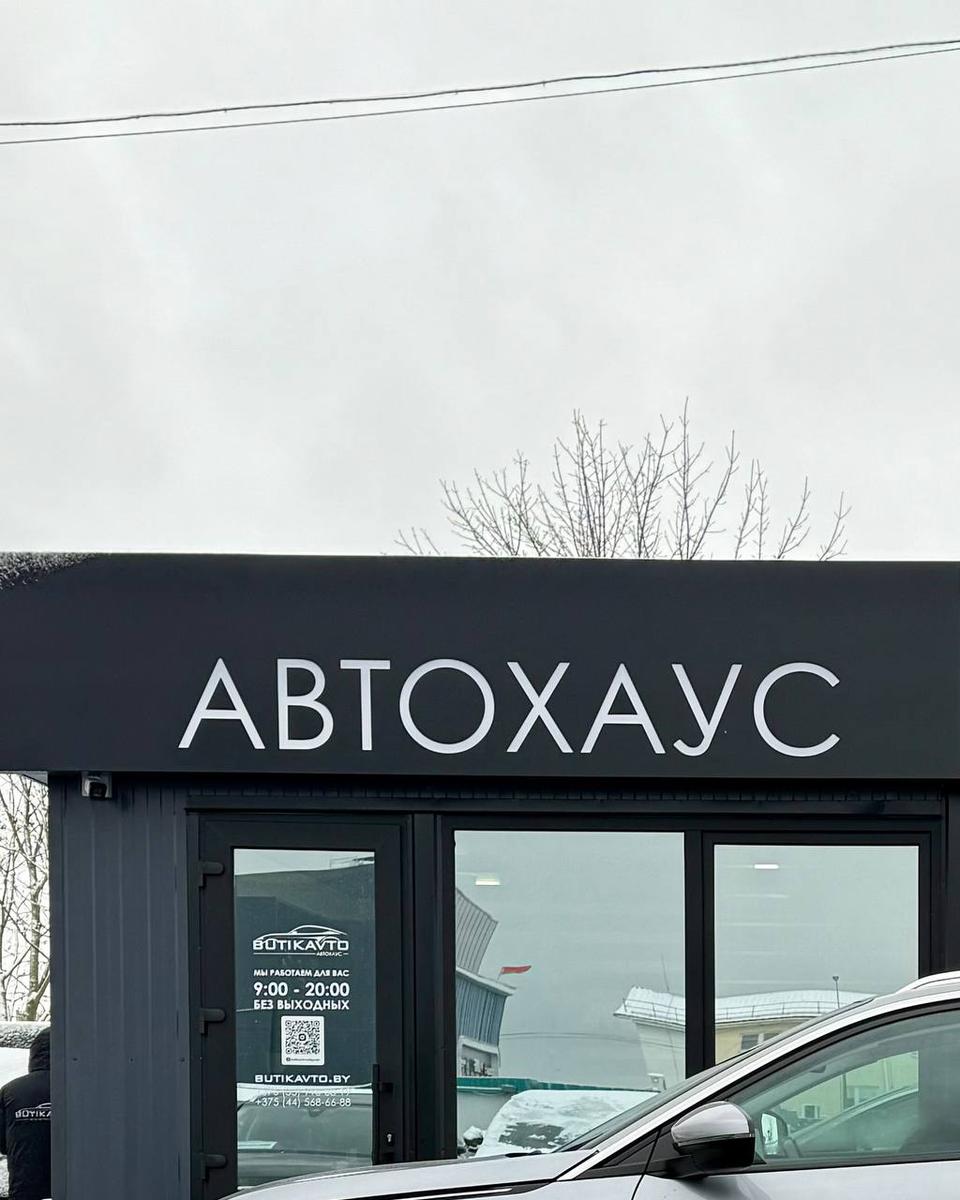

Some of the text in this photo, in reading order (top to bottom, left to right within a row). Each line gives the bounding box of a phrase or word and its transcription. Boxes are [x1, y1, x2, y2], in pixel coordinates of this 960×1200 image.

[178, 658, 841, 758] АВТОХАУС
[253, 940, 349, 950] BUTIKAVTO
[253, 969, 350, 977] МЫ РАБОТАЕМ ДЛЯ ВАС
[253, 981, 288, 996] 9:00
[304, 981, 350, 996] 20:00
[253, 999, 350, 1011] БЕЗ ВЫХОДНЫХ
[254, 1074, 351, 1083] BUTIKAVTO.BY
[255, 1098, 280, 1107] +375
[282, 1097, 301, 1108] (44)
